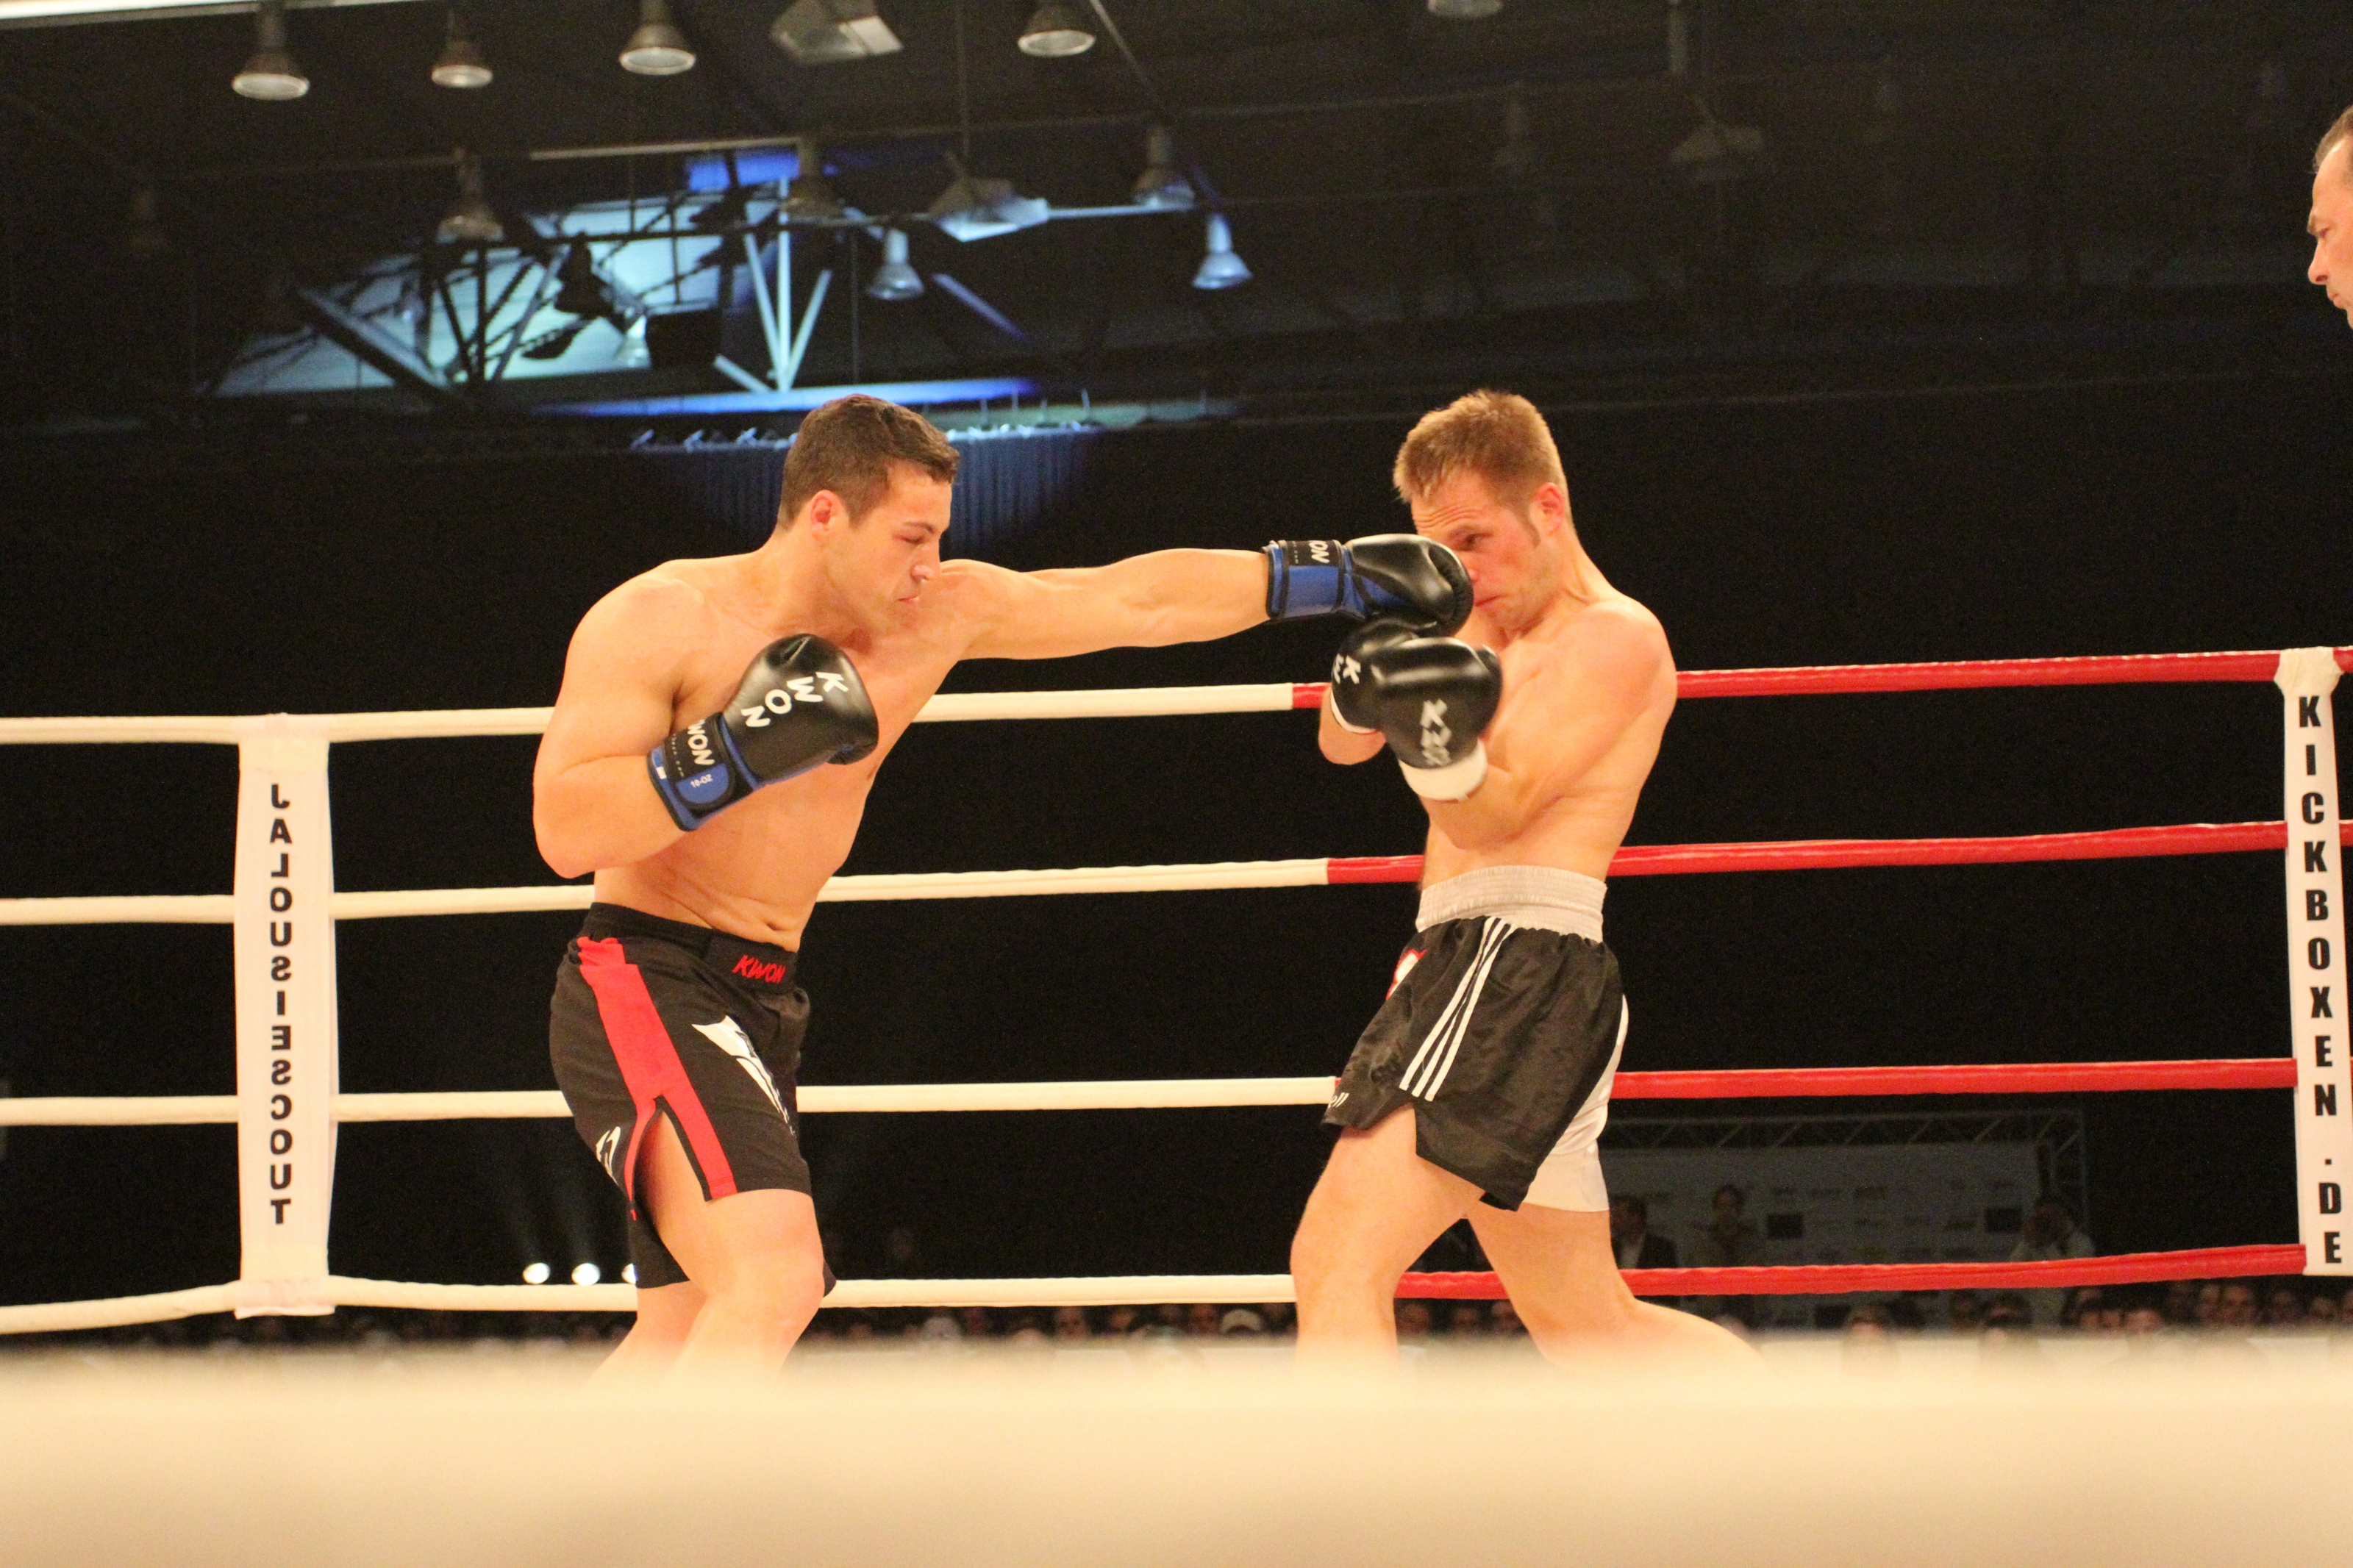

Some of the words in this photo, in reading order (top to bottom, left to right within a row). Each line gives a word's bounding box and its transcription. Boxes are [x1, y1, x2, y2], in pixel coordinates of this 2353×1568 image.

[740, 671, 849, 728] KWON
[687, 718, 716, 766] WON
[732, 954, 787, 984] KWON
